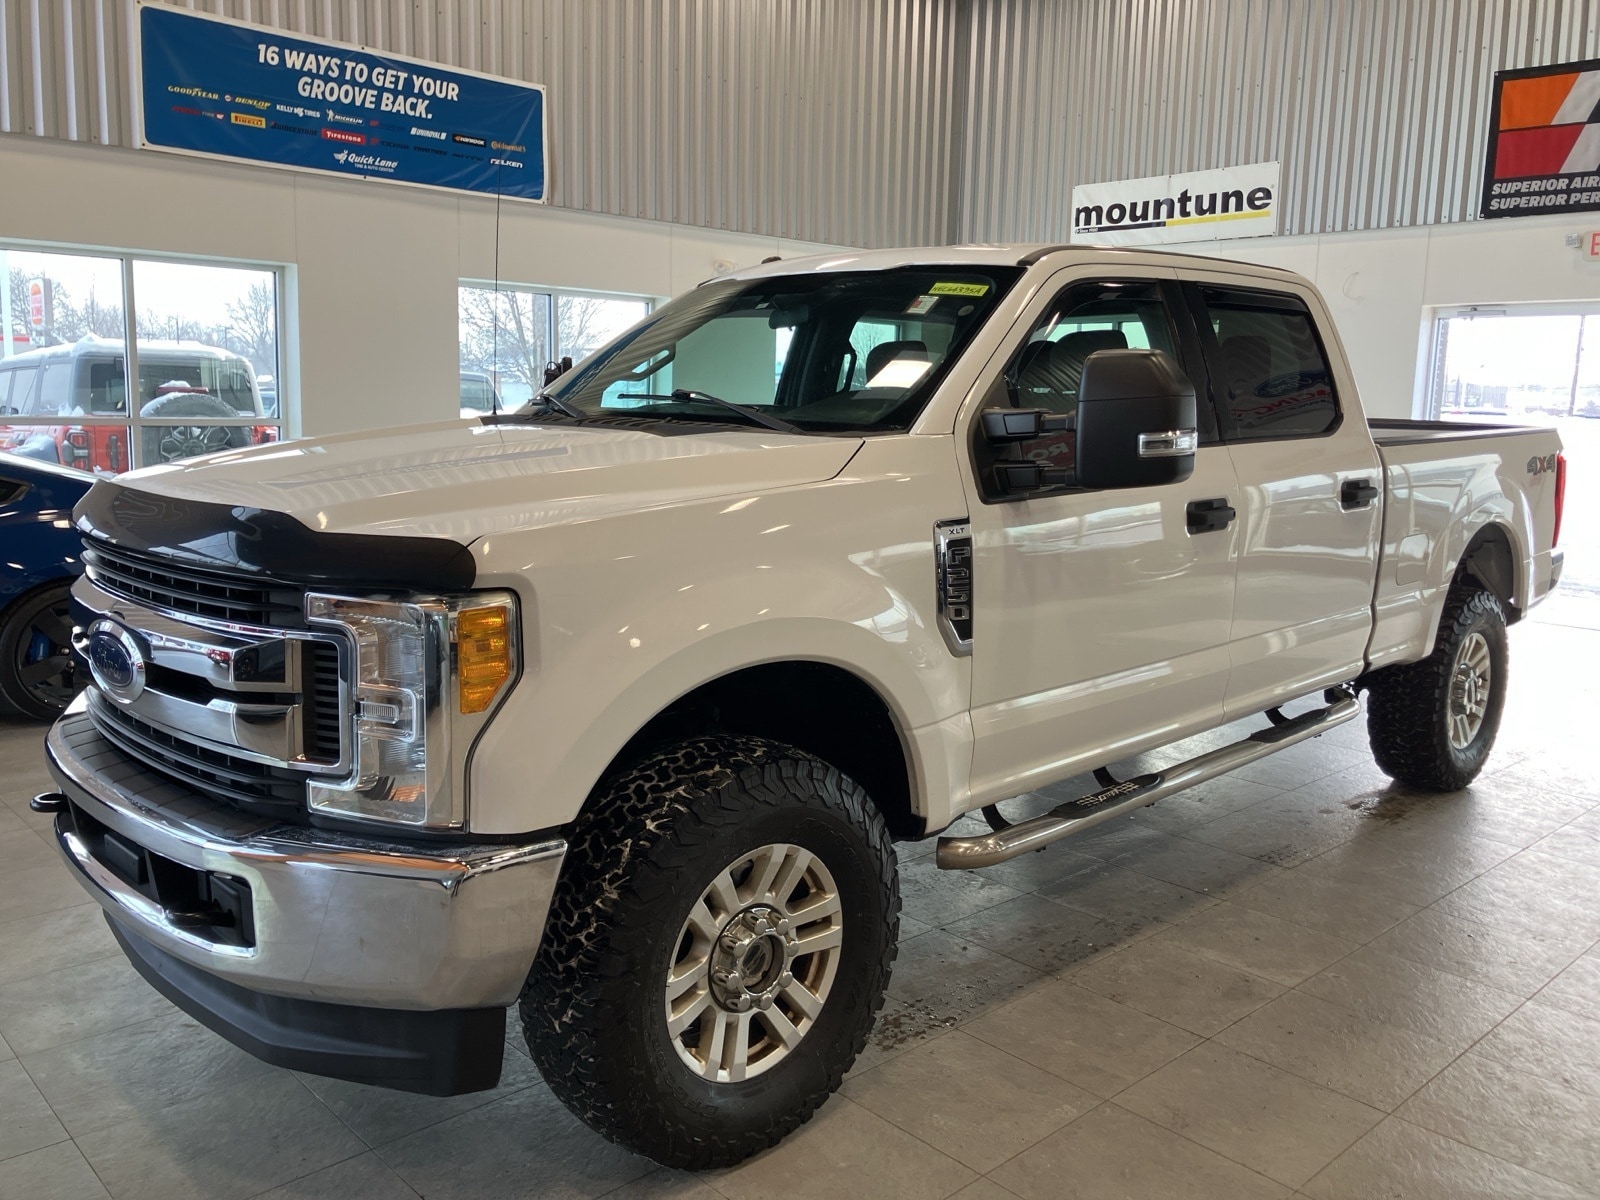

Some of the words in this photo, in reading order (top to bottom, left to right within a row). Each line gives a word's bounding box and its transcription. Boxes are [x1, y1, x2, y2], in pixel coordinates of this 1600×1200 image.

[258, 43, 279, 66] 16
[284, 48, 341, 79] WAYS
[344, 60, 369, 83] TO
[371, 67, 408, 91] GET
[411, 74, 460, 101] YOUR
[167, 85, 219, 100] GOODYEAR
[297, 76, 378, 109] GROOVE
[380, 92, 433, 119] BACK.
[234, 96, 271, 109] DUNLOP
[276, 103, 295, 114] KELLY
[303, 109, 320, 118] TIRES
[334, 114, 363, 124] MICHELIN
[347, 152, 375, 165] Quick
[375, 157, 399, 168] Lane
[489, 158, 523, 169] FALKEN
[1491, 177, 1569, 195] SUPERIOR
[1570, 175, 1600, 189] AIR
[1074, 186, 1273, 227] mountune
[1489, 193, 1568, 210] SUPERIOR
[948, 527, 965, 535] XLT
